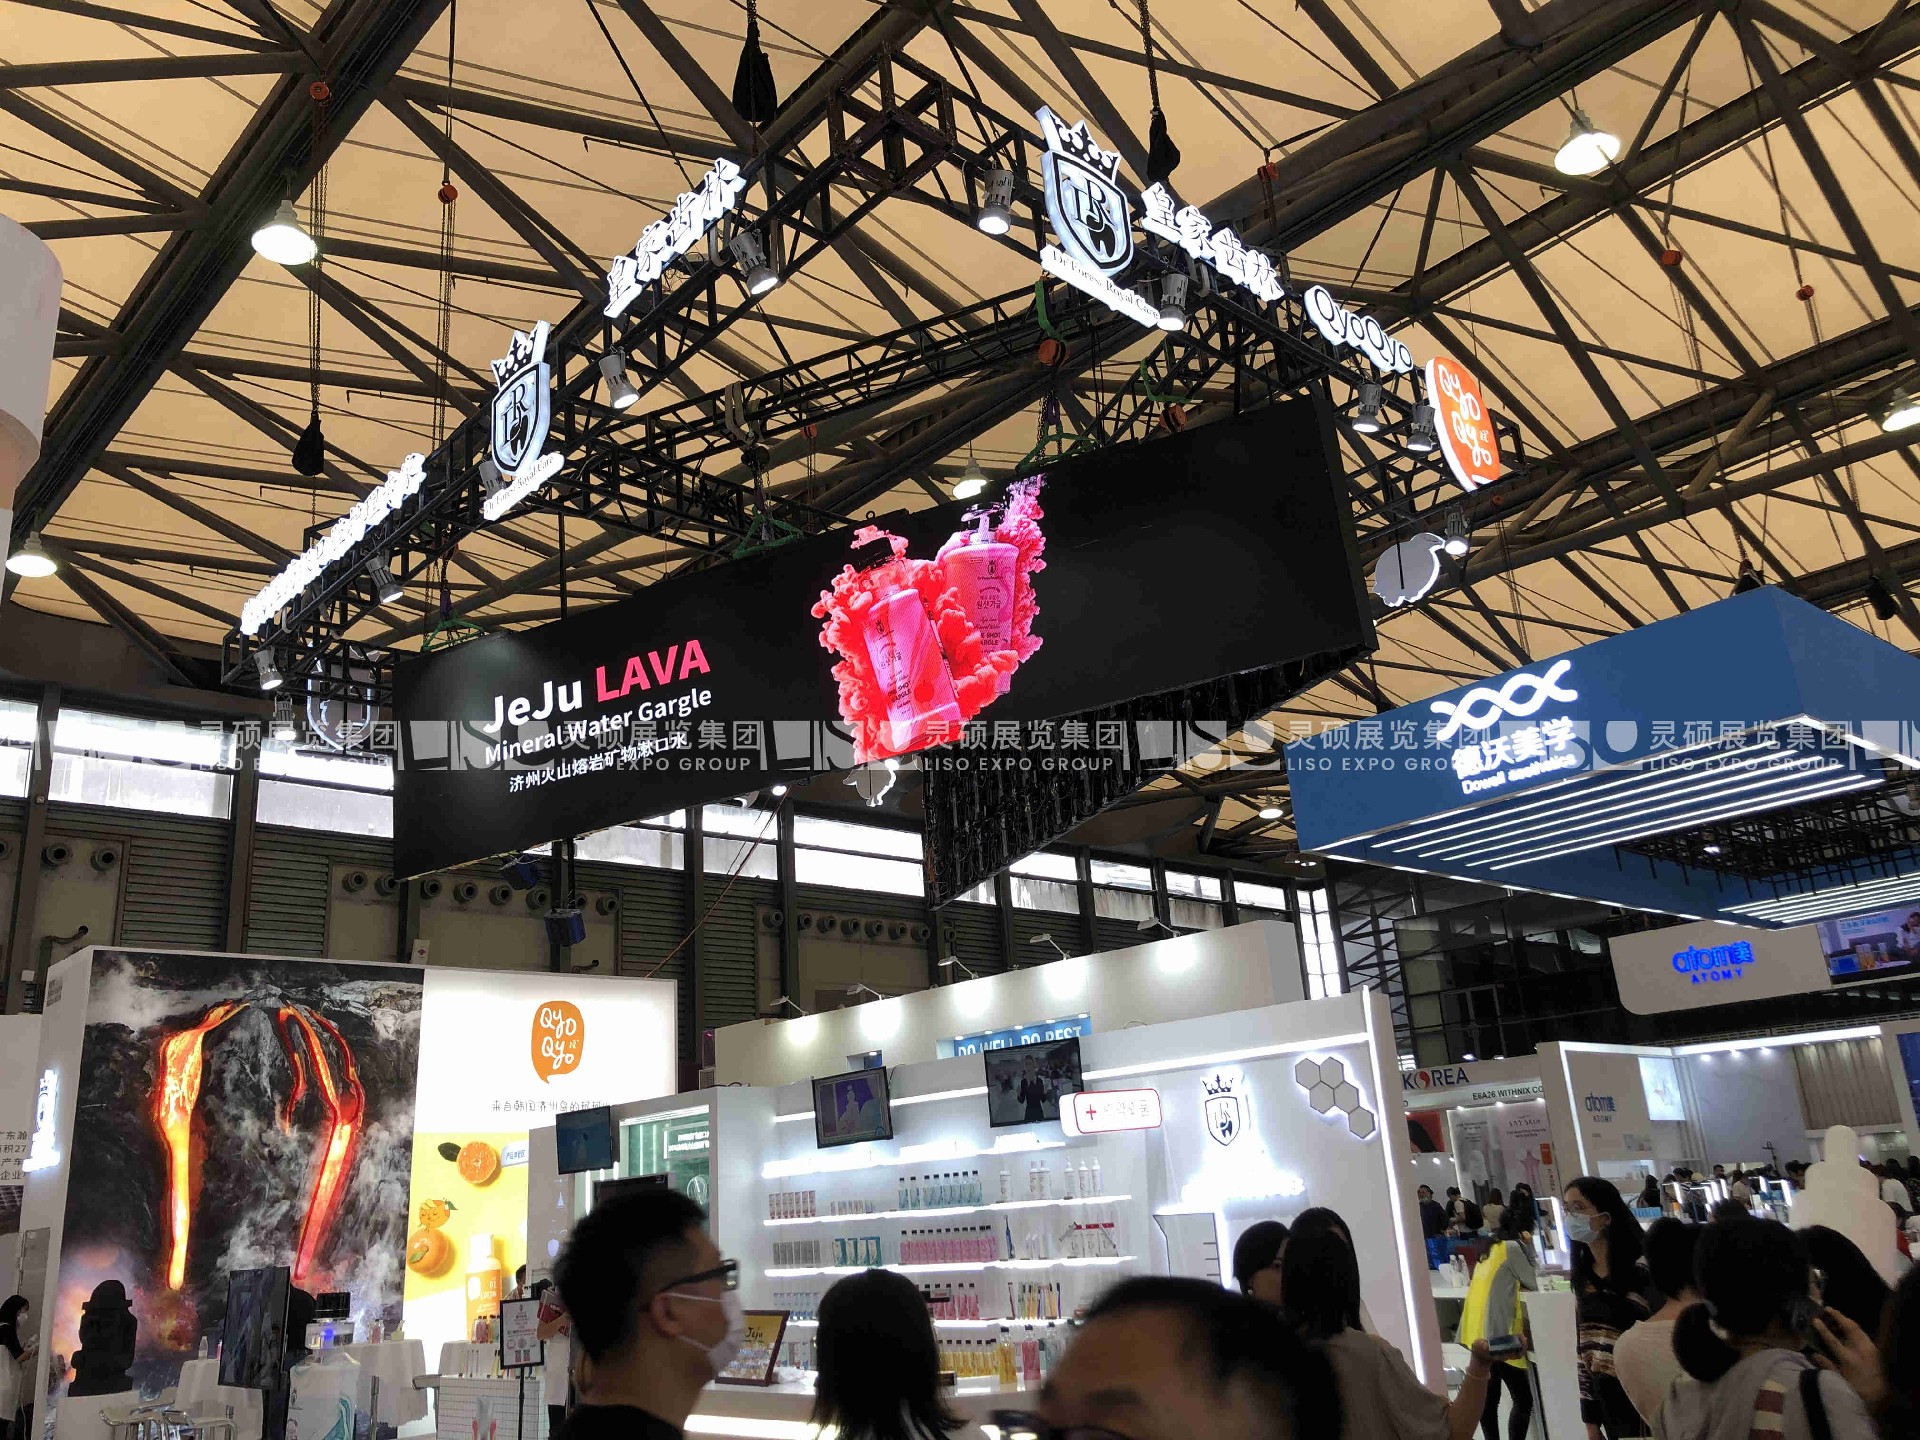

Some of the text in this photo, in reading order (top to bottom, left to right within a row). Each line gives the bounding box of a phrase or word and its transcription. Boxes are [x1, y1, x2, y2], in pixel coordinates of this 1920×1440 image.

[1105, 278, 1133, 304] Royal
[1315, 288, 1413, 369] QyoQyo
[483, 639, 711, 733] JeJu LAVA
[485, 726, 563, 765] Mineral
[568, 709, 634, 742] Water
[638, 688, 712, 722] Gargle
[509, 732, 689, 793] 济州火山熔岩矿物漱口水
[1691, 967, 1743, 984] ATOMY
[1402, 1067, 1470, 1090] KOREA
[745, 1326, 763, 1340] Jeju
